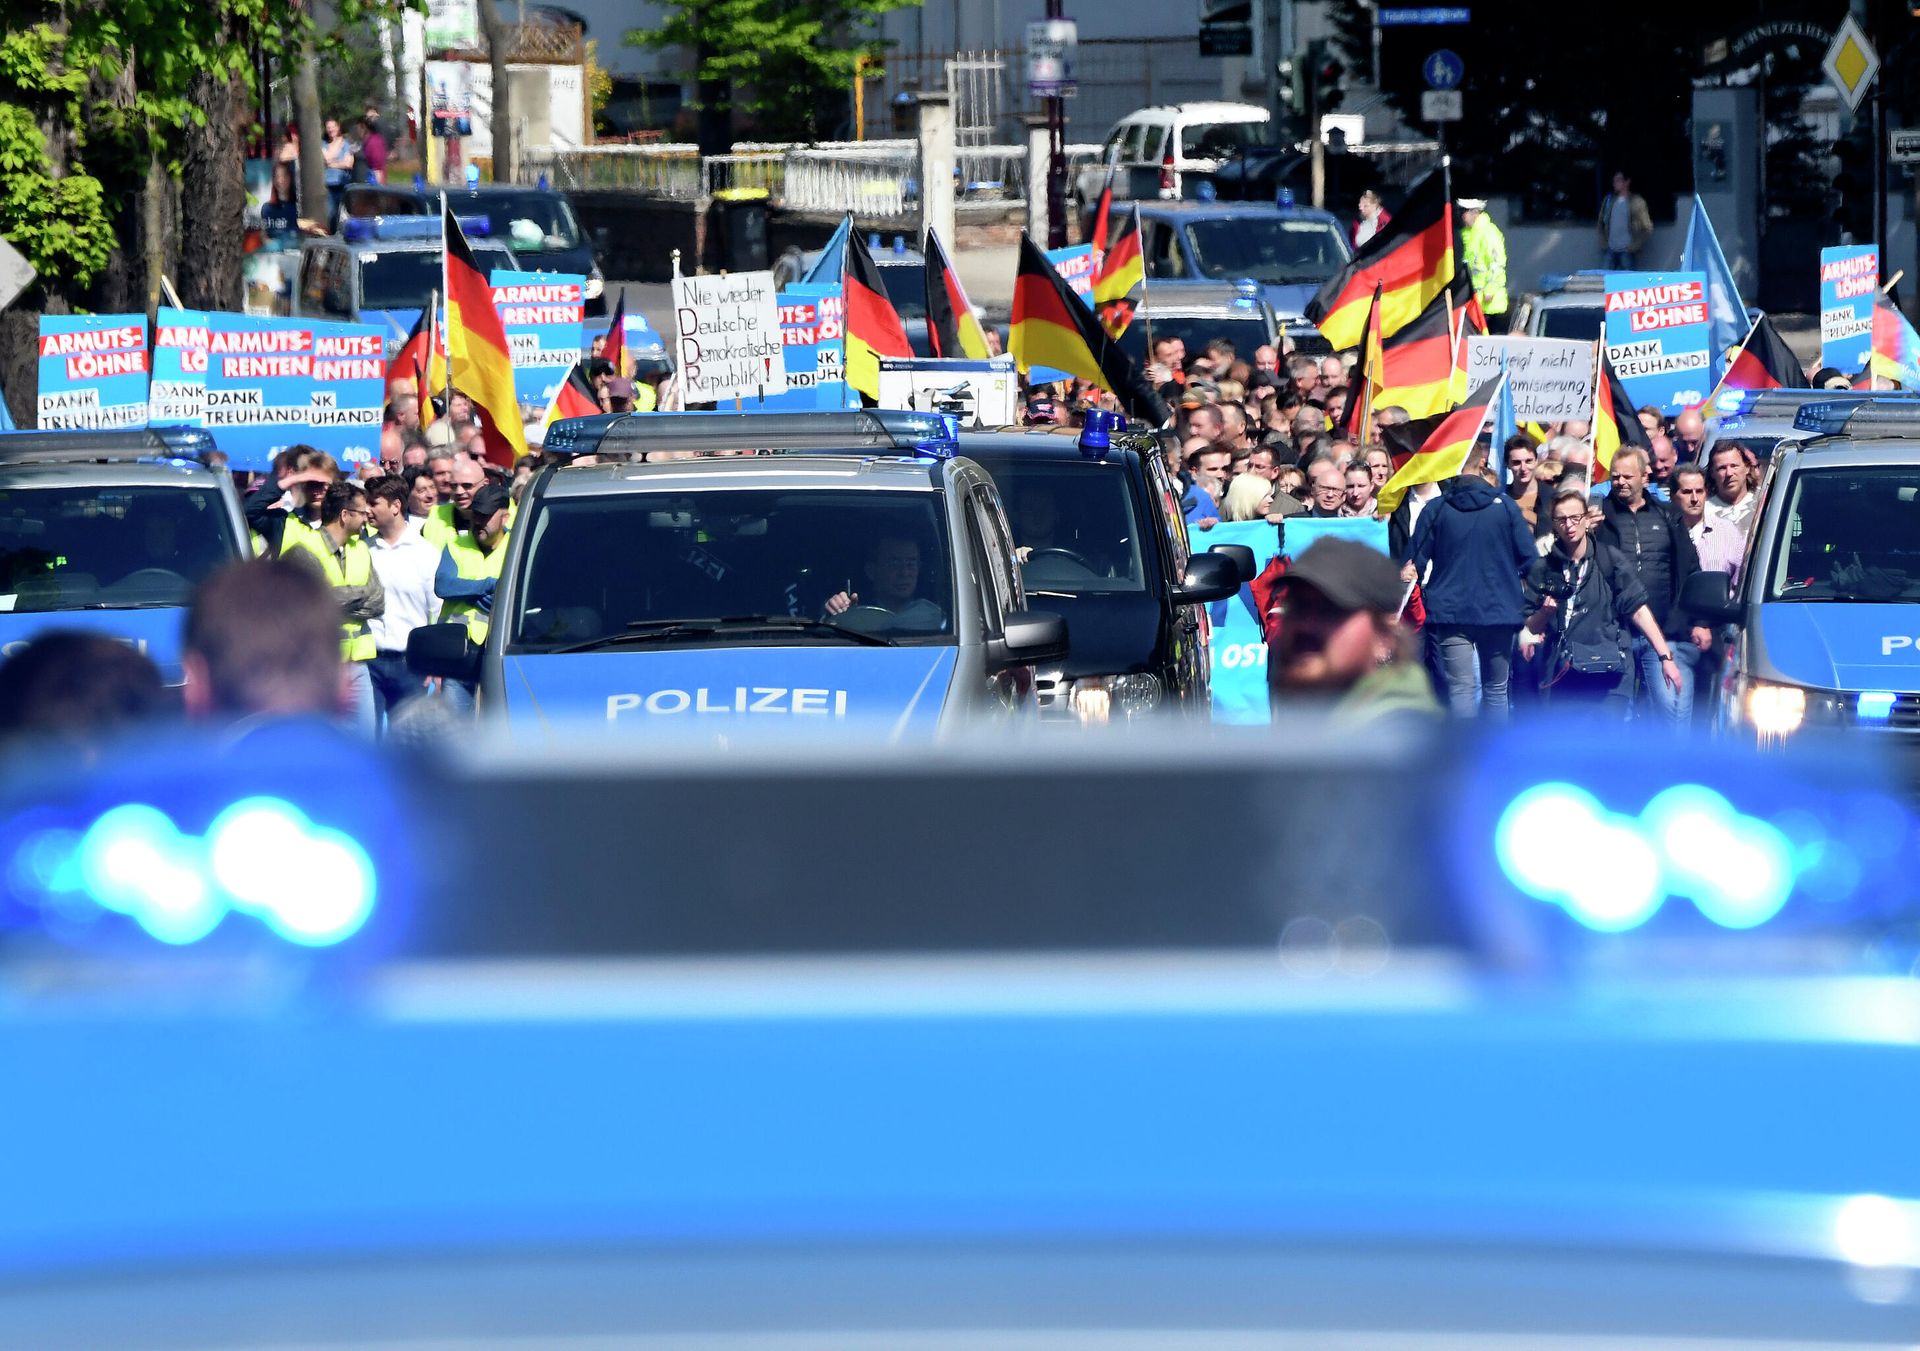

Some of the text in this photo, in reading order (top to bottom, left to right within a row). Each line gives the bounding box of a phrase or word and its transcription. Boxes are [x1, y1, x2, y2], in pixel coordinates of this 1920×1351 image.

[1823, 255, 1875, 280] ARMUTS-
[492, 285, 580, 303] ARMUTS-
[683, 278, 765, 306] Nie wieder
[1608, 283, 1701, 312] ARMUTS-
[504, 307, 578, 324] RENTEN
[678, 306, 757, 337] Deutsche
[1632, 305, 1704, 330] LÖHNE
[1825, 309, 1853, 323] DANK
[43, 328, 142, 356] ARMUTS-
[210, 331, 311, 352] ARMUTS-
[682, 332, 780, 366] Demokratische
[1611, 342, 1658, 360] DANK
[68, 351, 143, 379] LÖHNE
[224, 356, 310, 376] RENTEN
[1541, 348, 1575, 368] nicht
[1510, 376, 1586, 395] amisierung
[43, 391, 96, 411] DANK
[207, 391, 258, 405] DANK
[205, 408, 308, 424] TREUHAND!
[311, 410, 380, 424] UHAND!
[606, 686, 847, 719] POLIZEI
